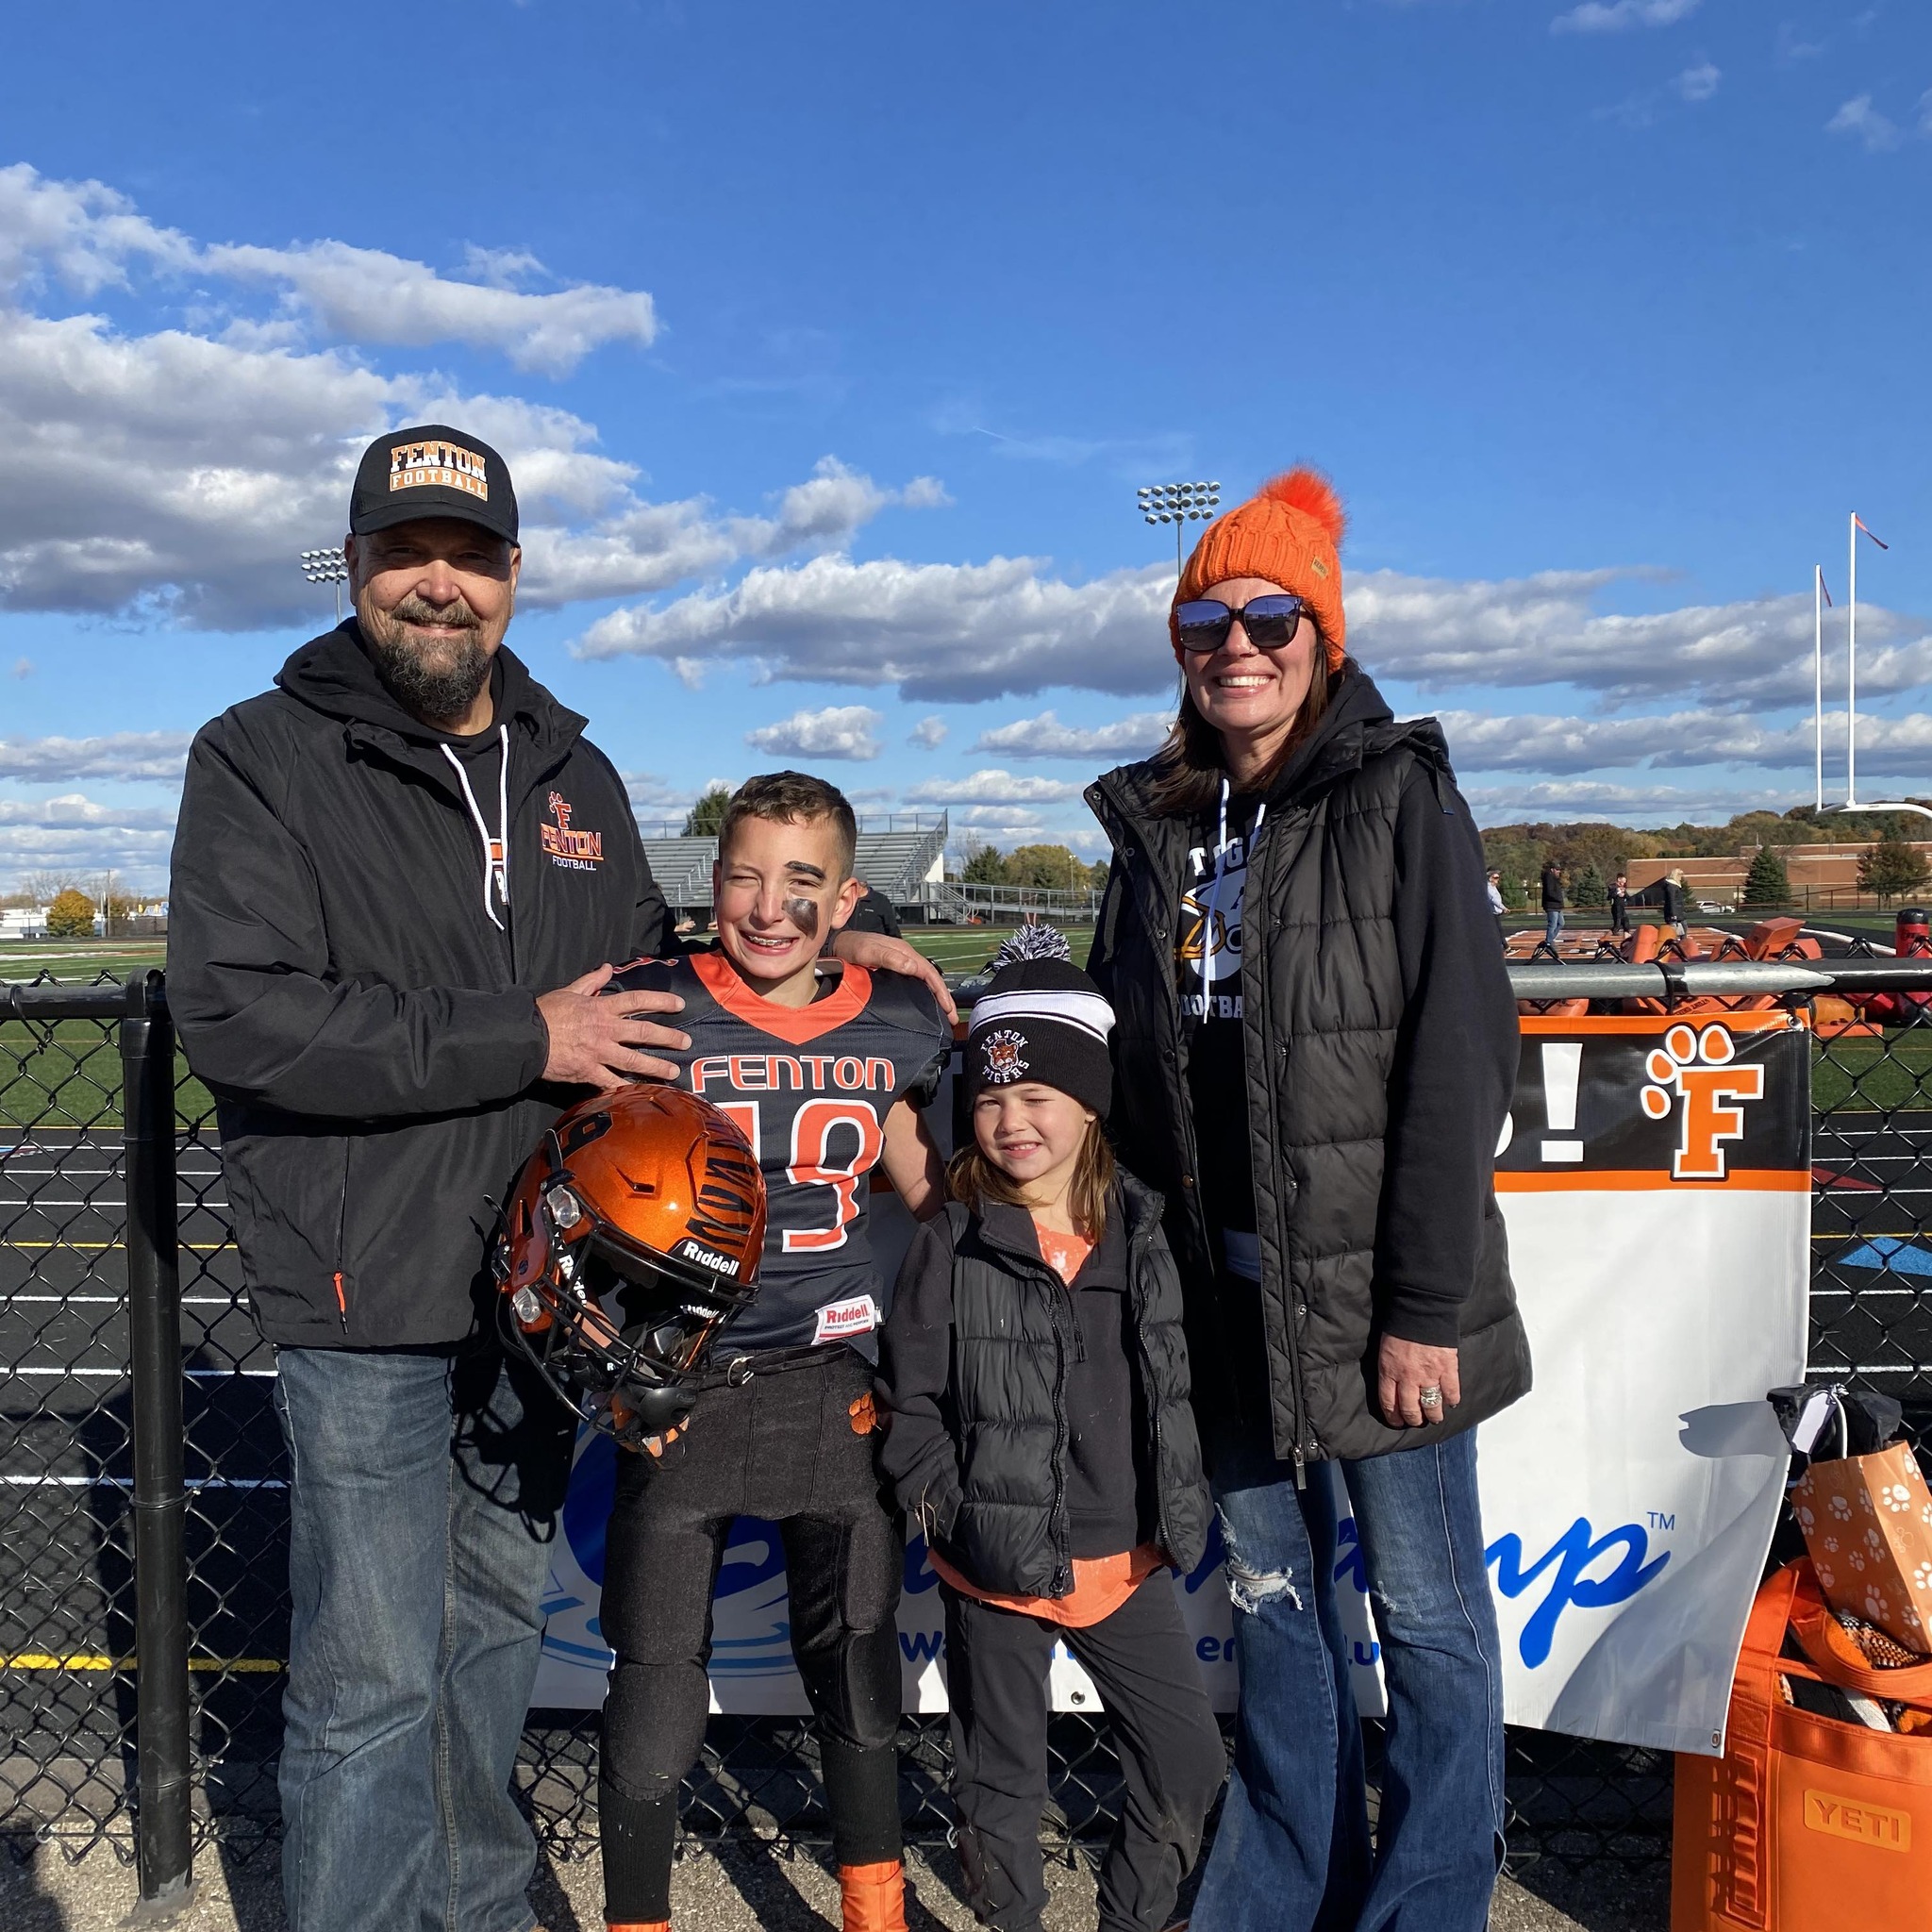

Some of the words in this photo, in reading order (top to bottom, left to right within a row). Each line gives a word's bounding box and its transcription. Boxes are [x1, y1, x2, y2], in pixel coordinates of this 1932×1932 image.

[390, 441, 487, 482] FENTON
[391, 469, 486, 498] FOOTBALL
[555, 802, 572, 829] F
[541, 824, 602, 857] FENTON
[552, 855, 596, 871] FOOTBALL
[1180, 994, 1243, 1018] OOTBA
[980, 1029, 1029, 1052] FENTON
[691, 1054, 896, 1093] FENTON
[981, 1059, 1030, 1084] TIGERS
[682, 1241, 740, 1276] Riddell
[826, 1304, 868, 1324] Riddell
[1813, 1798, 1900, 1842] YETI
